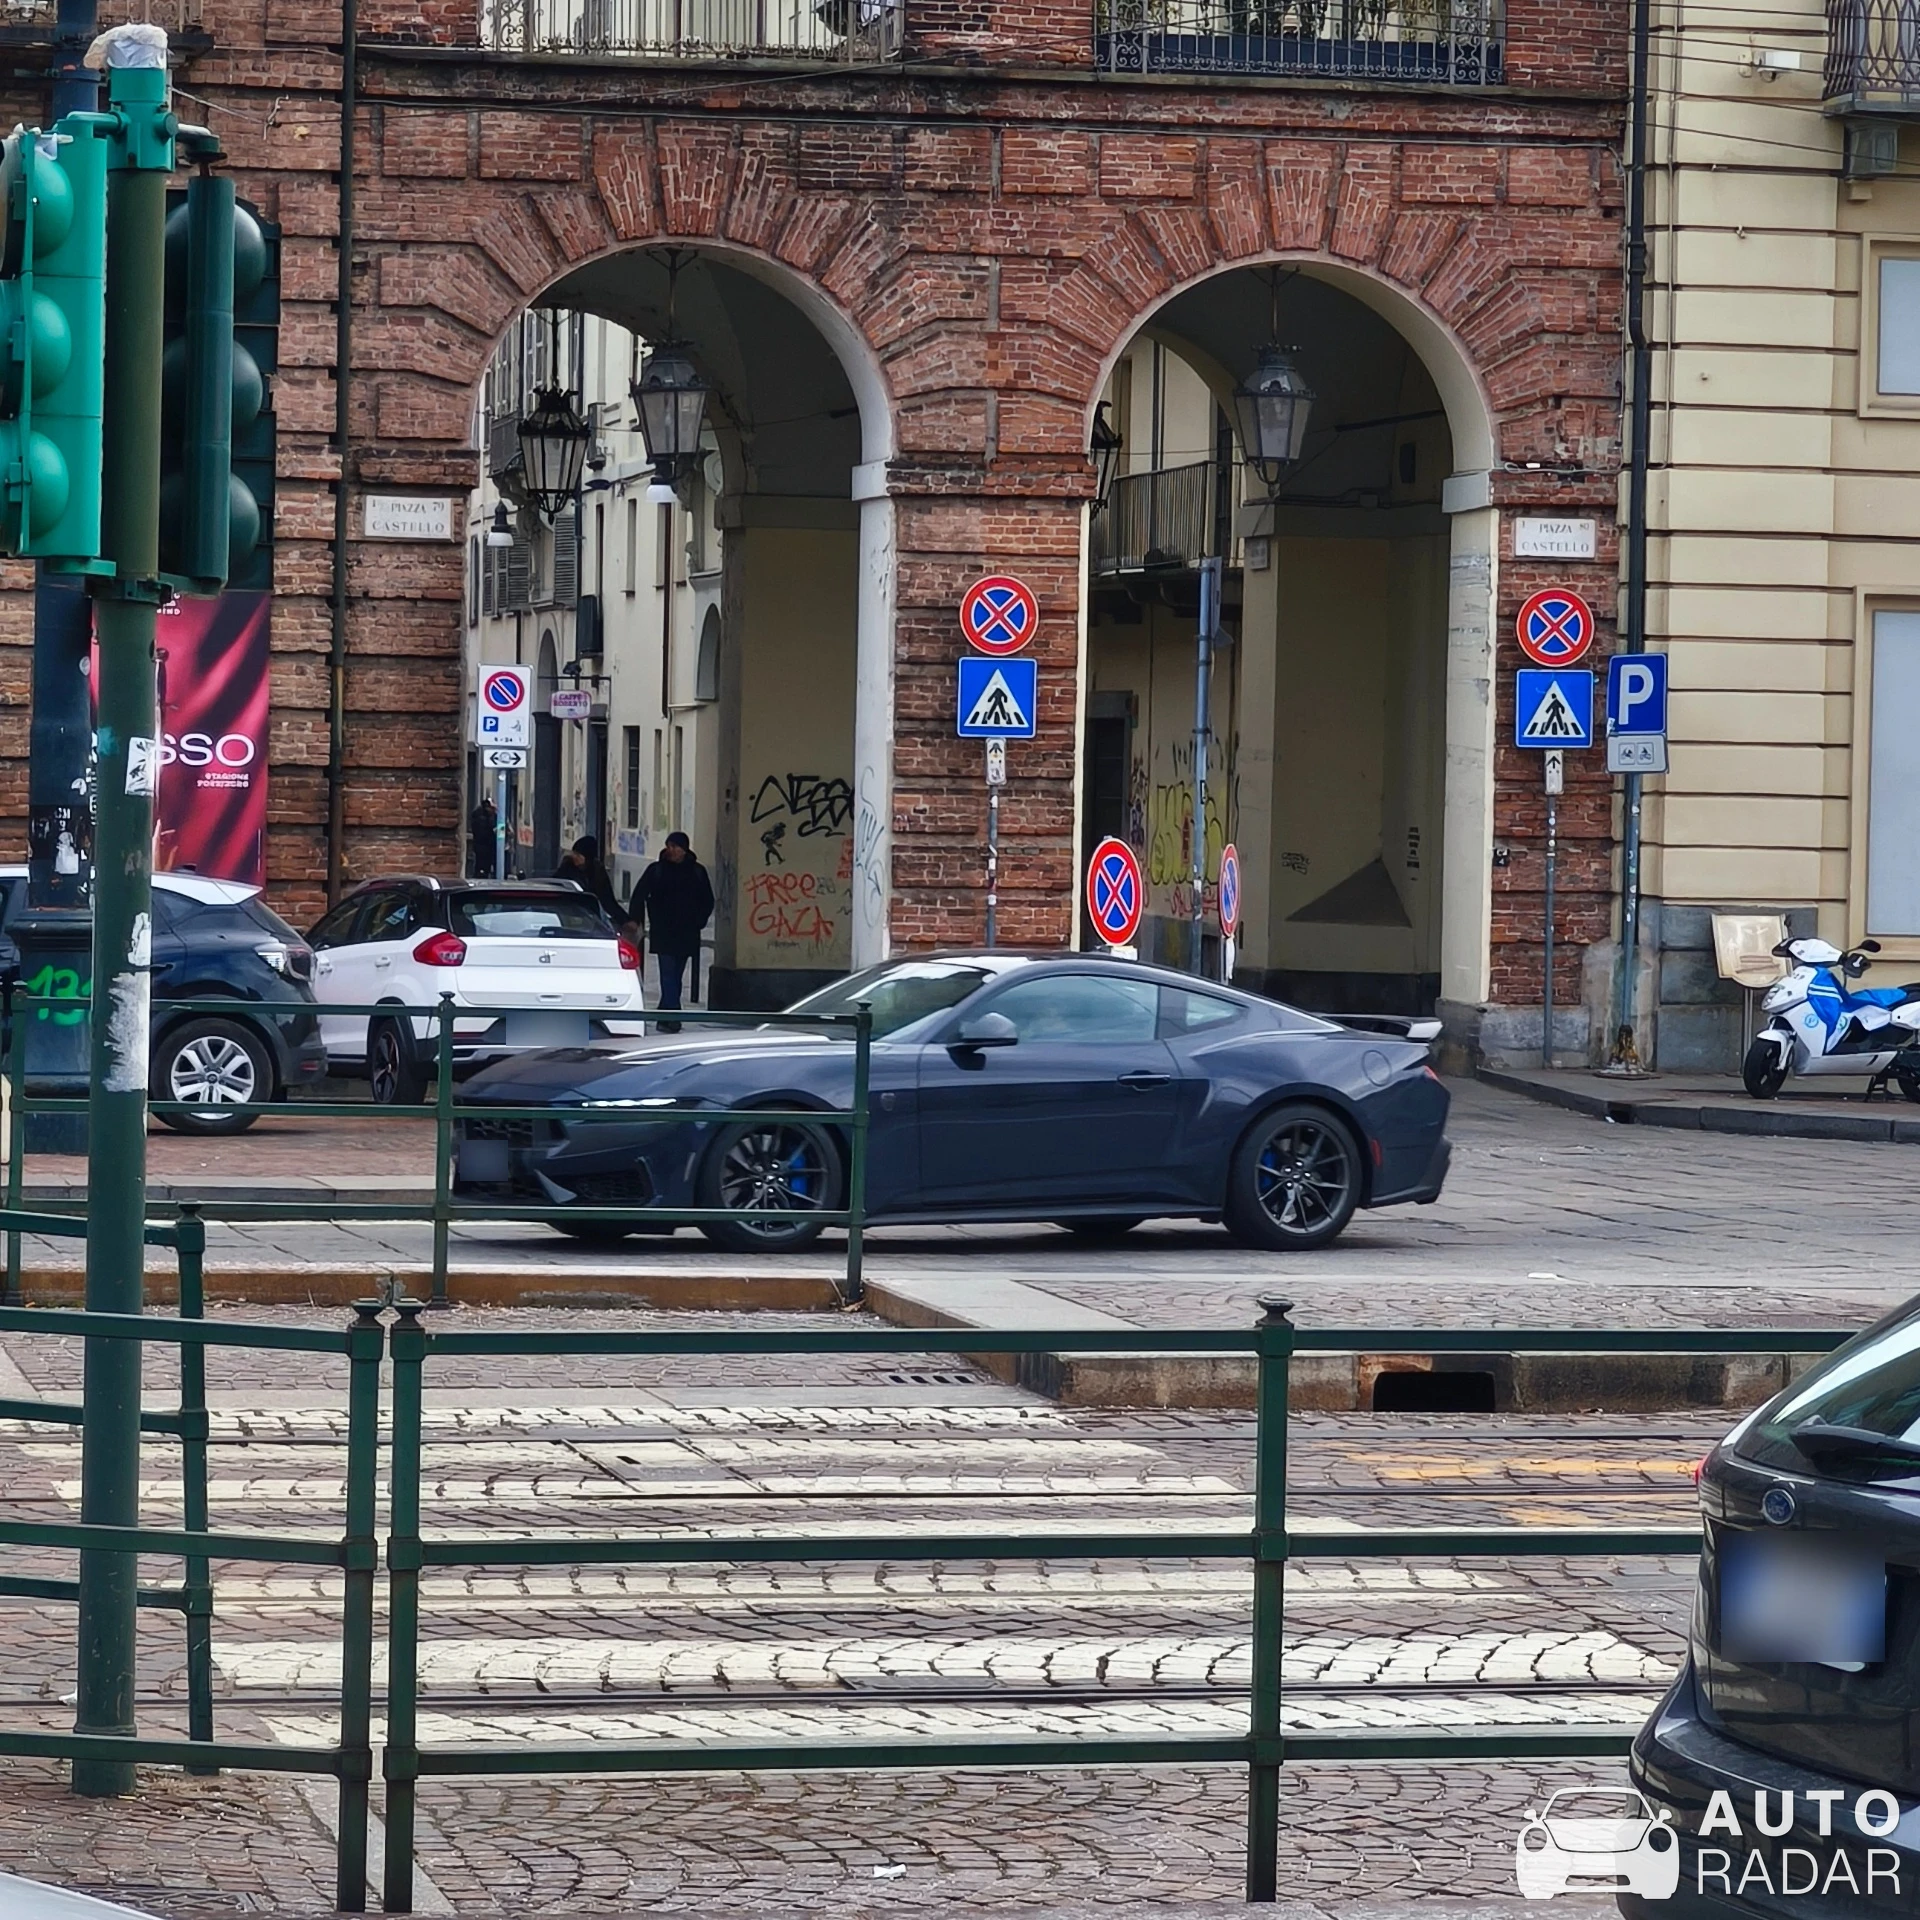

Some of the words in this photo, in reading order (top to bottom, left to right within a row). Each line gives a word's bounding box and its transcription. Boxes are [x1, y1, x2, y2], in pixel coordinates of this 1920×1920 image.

[391, 503, 426, 514] PIAZZA
[372, 520, 445, 533] CASTELLO
[1539, 523, 1572, 533] PIAZZA
[1521, 541, 1590, 553] CASTELLO
[1618, 664, 1654, 725] P
[486, 718, 496, 730] P
[750, 902, 834, 944] GAZA
